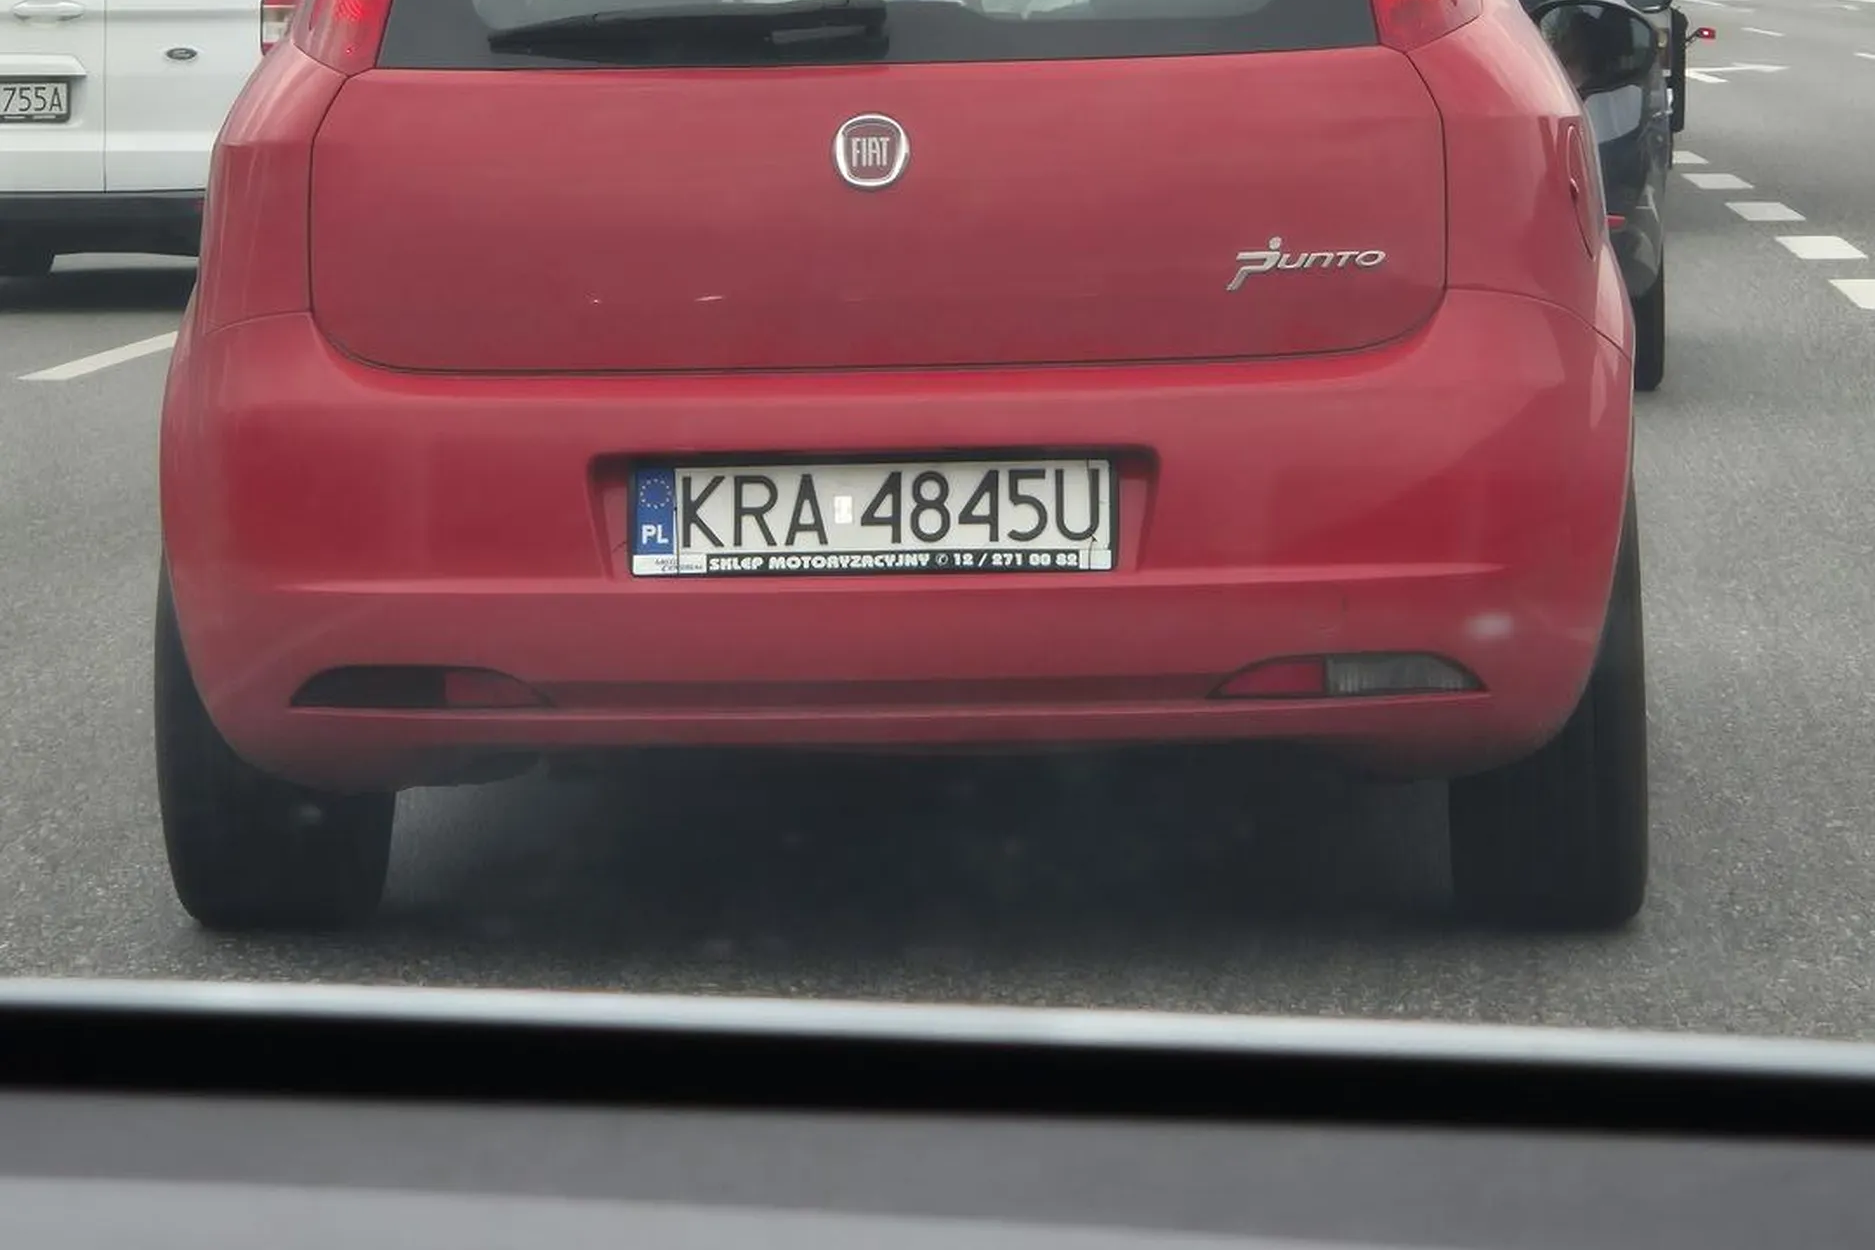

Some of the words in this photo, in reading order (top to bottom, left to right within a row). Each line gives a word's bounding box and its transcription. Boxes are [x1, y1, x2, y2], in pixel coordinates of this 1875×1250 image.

[2, 86, 63, 112] 755A
[851, 137, 890, 167] FIAT
[682, 473, 828, 548] KRA
[860, 468, 1101, 545] 4845U
[642, 524, 669, 545] PL
[708, 556, 764, 571] SKLEP
[768, 553, 931, 570] MOTORYZACYJNY
[953, 553, 973, 566] 12
[978, 552, 987, 567] /
[992, 553, 1023, 566] 271
